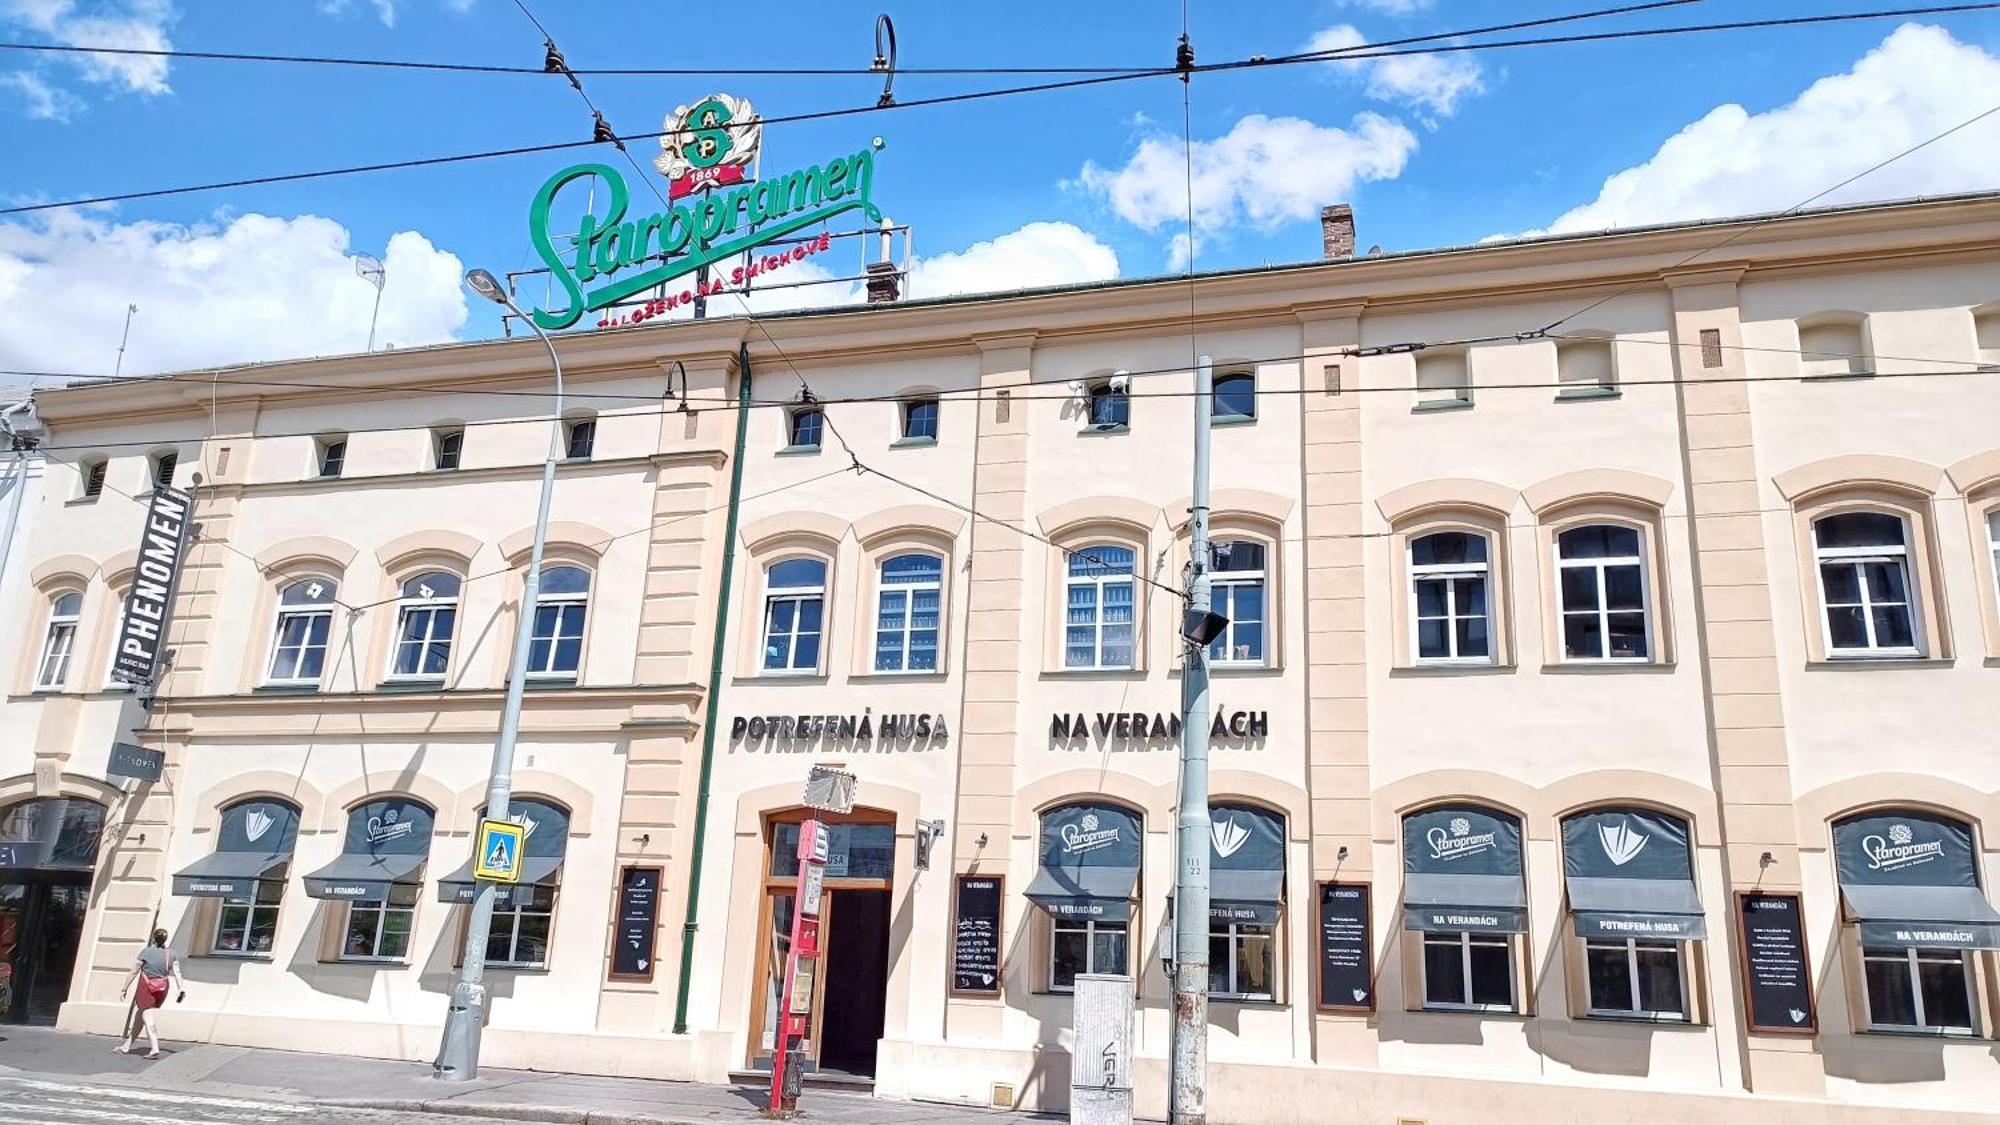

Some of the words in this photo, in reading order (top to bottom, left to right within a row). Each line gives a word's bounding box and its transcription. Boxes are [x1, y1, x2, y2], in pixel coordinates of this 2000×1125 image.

[690, 167, 721, 183] 1869
[529, 148, 883, 329] Staropramen
[697, 278, 723, 298] NA
[123, 496, 185, 660] PHENOMEN
[732, 707, 873, 740] POTREFENÁ
[880, 714, 949, 739] HUSA
[1052, 713, 1089, 738] NA
[1097, 703, 1268, 738] VERANÁCH
[1061, 824, 1120, 853] Staropramen
[1427, 827, 1497, 859] Staropramen
[1862, 835, 1945, 869] Staropramen
[1190, 867, 1201, 875] 22
[1209, 907, 1233, 917] EFENÁ
[1433, 915, 1445, 924] NA
[1447, 914, 1498, 925] VERANDÁCH
[1655, 922, 1679, 932] HUSA
[1897, 931, 1911, 940] NA
[1912, 929, 1973, 942] VERANDÁCH
